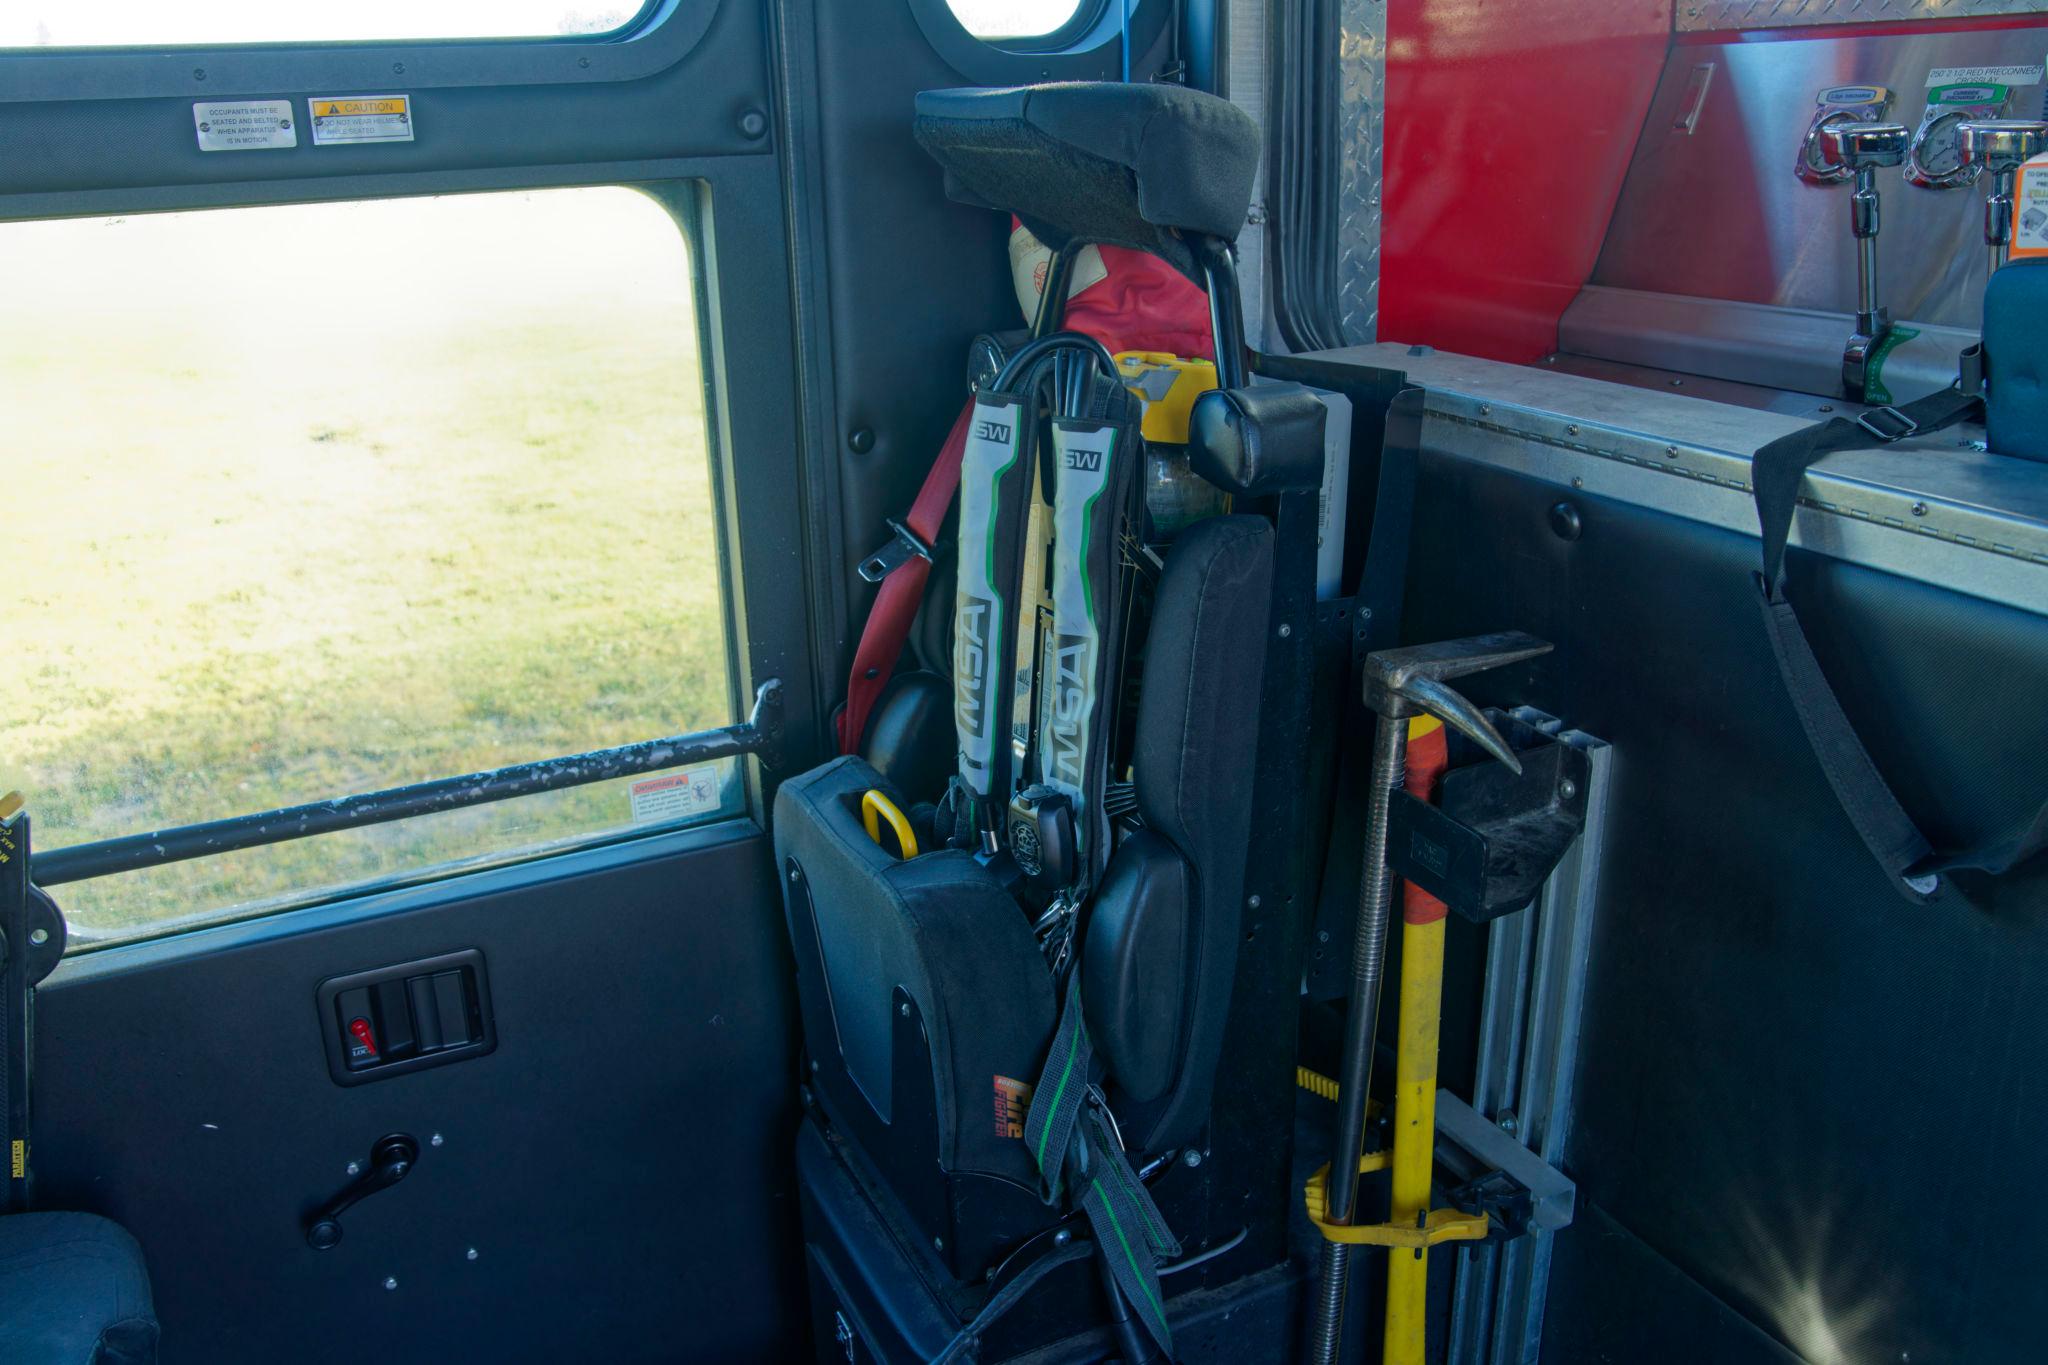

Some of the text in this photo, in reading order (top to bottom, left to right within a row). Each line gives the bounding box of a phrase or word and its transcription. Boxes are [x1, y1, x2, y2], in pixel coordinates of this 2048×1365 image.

[1966, 68, 1984, 77] RED
[1984, 66, 2043, 76] PRECONNECT
[1955, 76, 2000, 84] CROSSLAY
[209, 106, 279, 116] OCCUPANTS MUST BE
[344, 102, 394, 113] CAUTION
[212, 116, 279, 126] SEATED AND BELTED
[324, 117, 401, 127] DO NOT WEAR HELME
[217, 126, 277, 136] WHEN APPARATUS
[347, 127, 375, 135] SEATED
[242, 136, 268, 144] MOTION
[1866, 392, 1888, 401] OPEN
[959, 604, 986, 729] MSA
[1052, 642, 1088, 778] MSA
[994, 1088, 1008, 1137] FIGHTER
